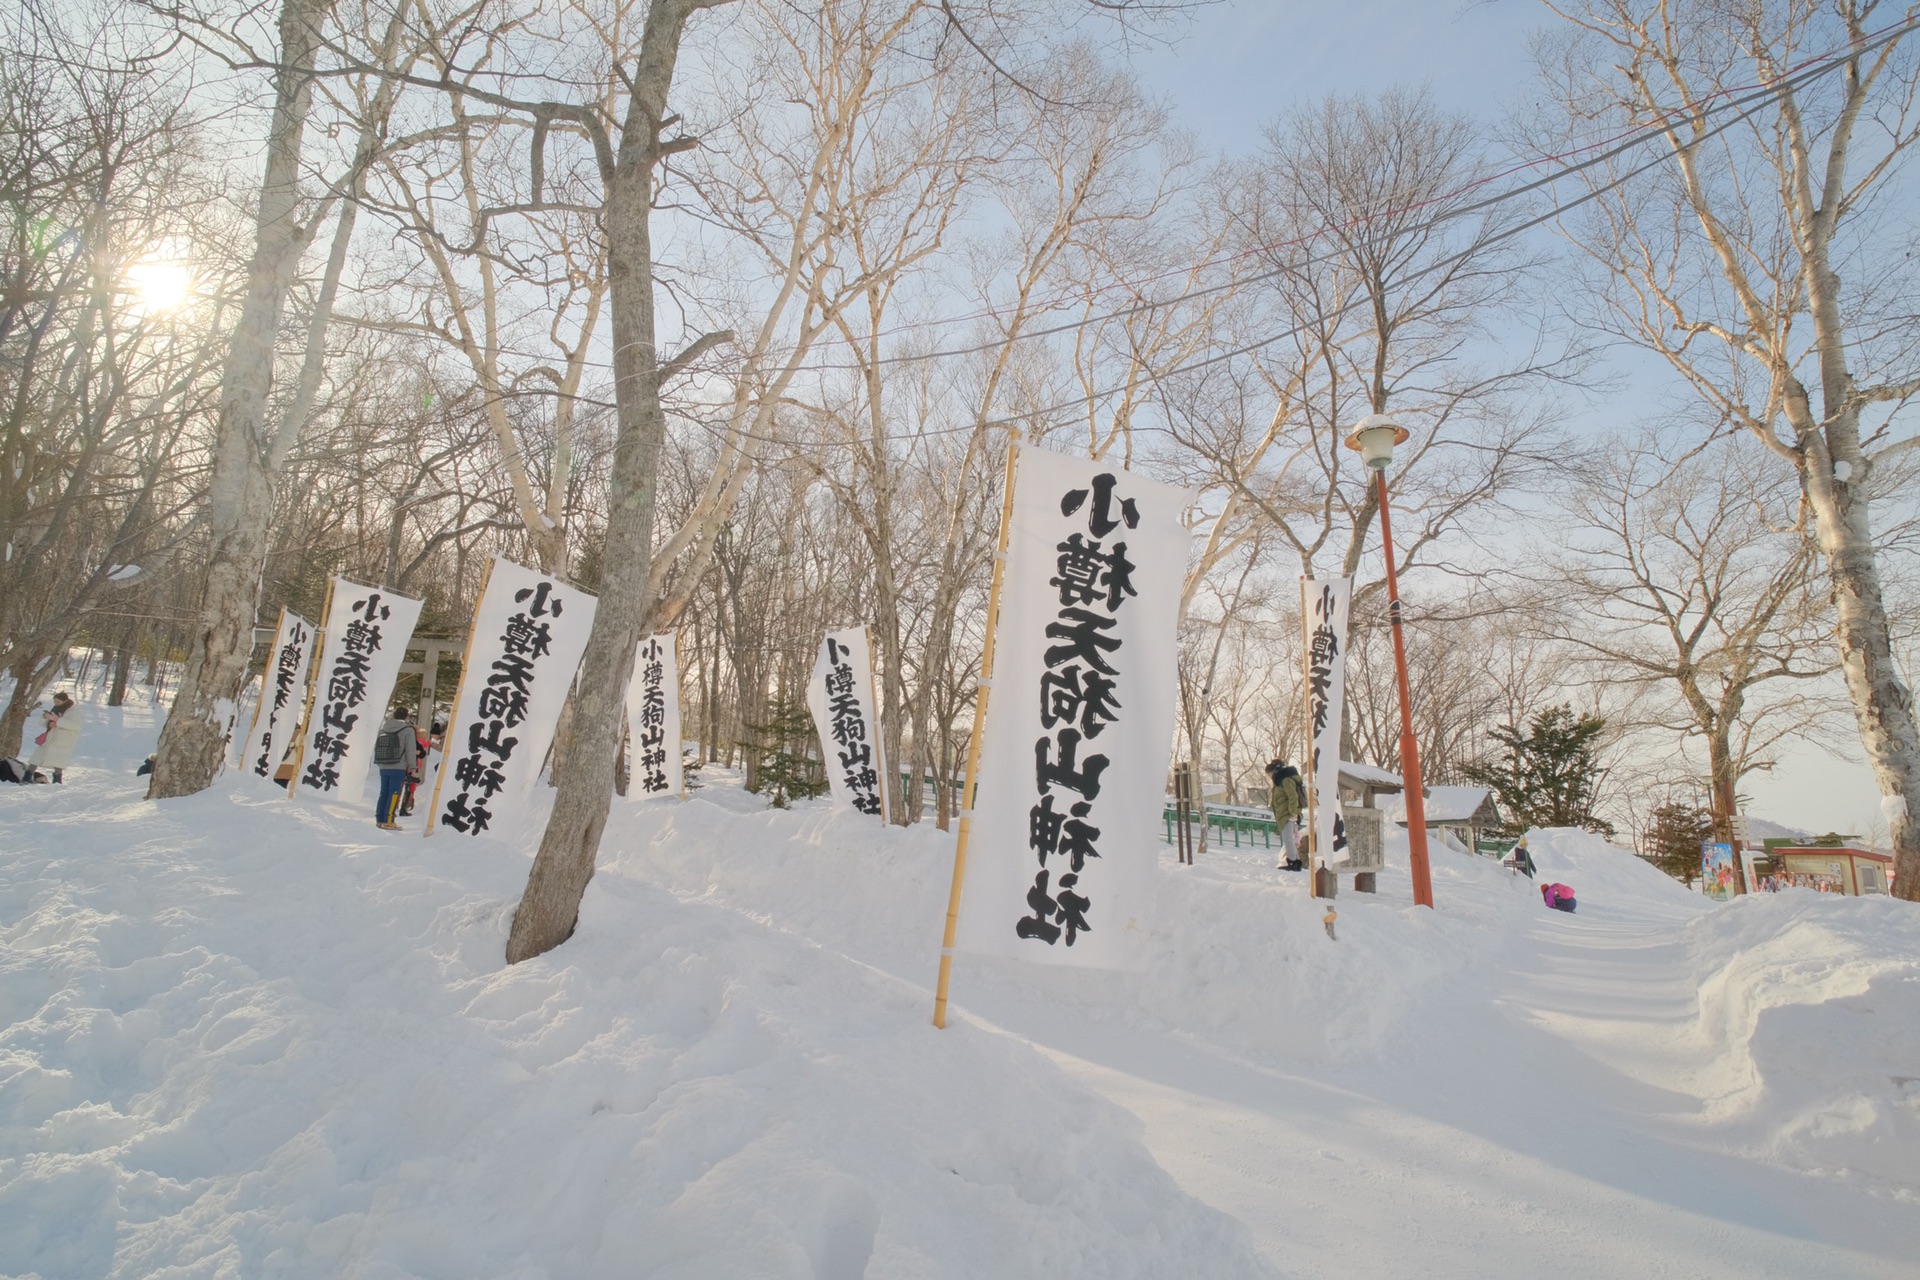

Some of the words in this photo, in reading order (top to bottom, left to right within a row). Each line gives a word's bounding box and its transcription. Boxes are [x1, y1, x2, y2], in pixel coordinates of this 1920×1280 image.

[641, 638, 669, 793] 小樽天狗山神社
